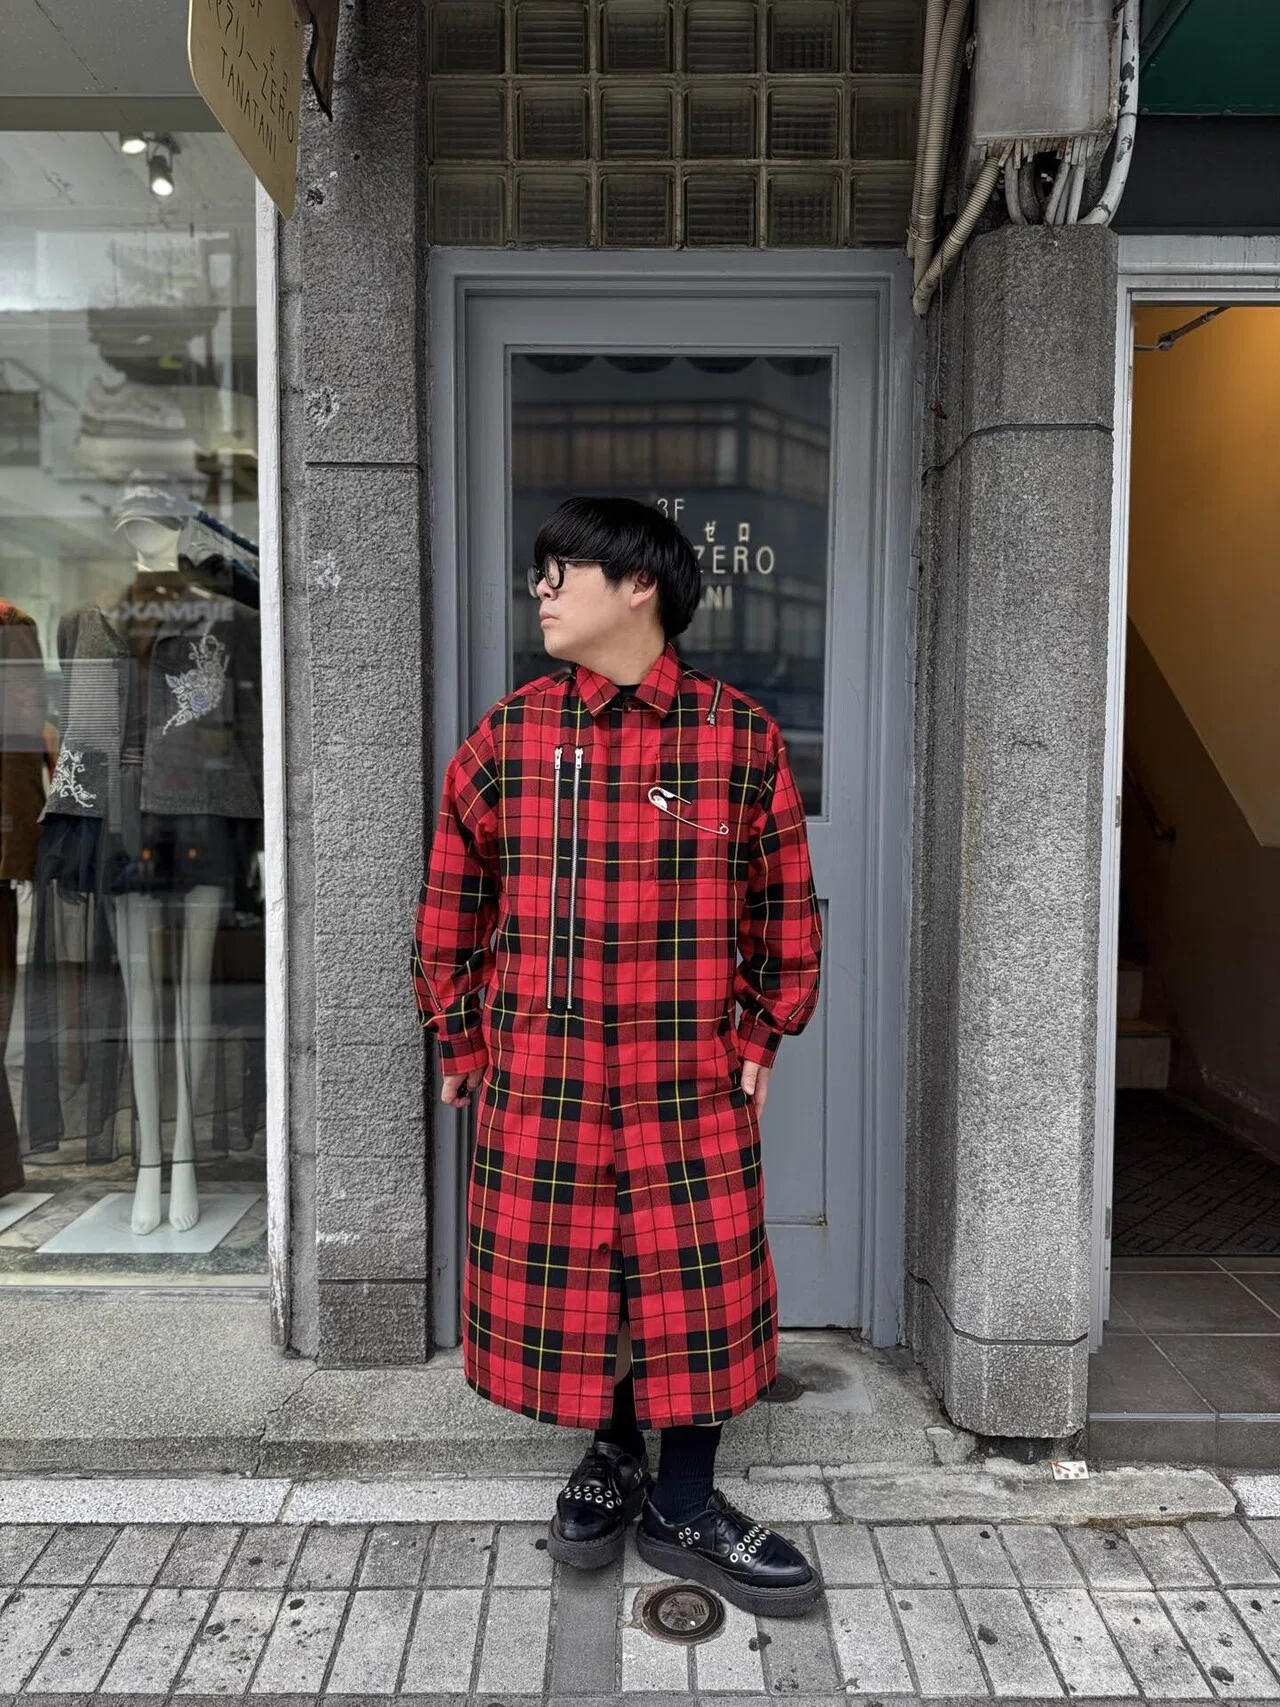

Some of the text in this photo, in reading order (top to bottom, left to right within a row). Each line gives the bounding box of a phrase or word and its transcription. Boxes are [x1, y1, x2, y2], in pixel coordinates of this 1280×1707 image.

[221, 46, 277, 163] TANATANI
[262, 62, 295, 144] ZERO
[657, 498, 686, 521] 3F
[699, 585, 733, 610] NI
